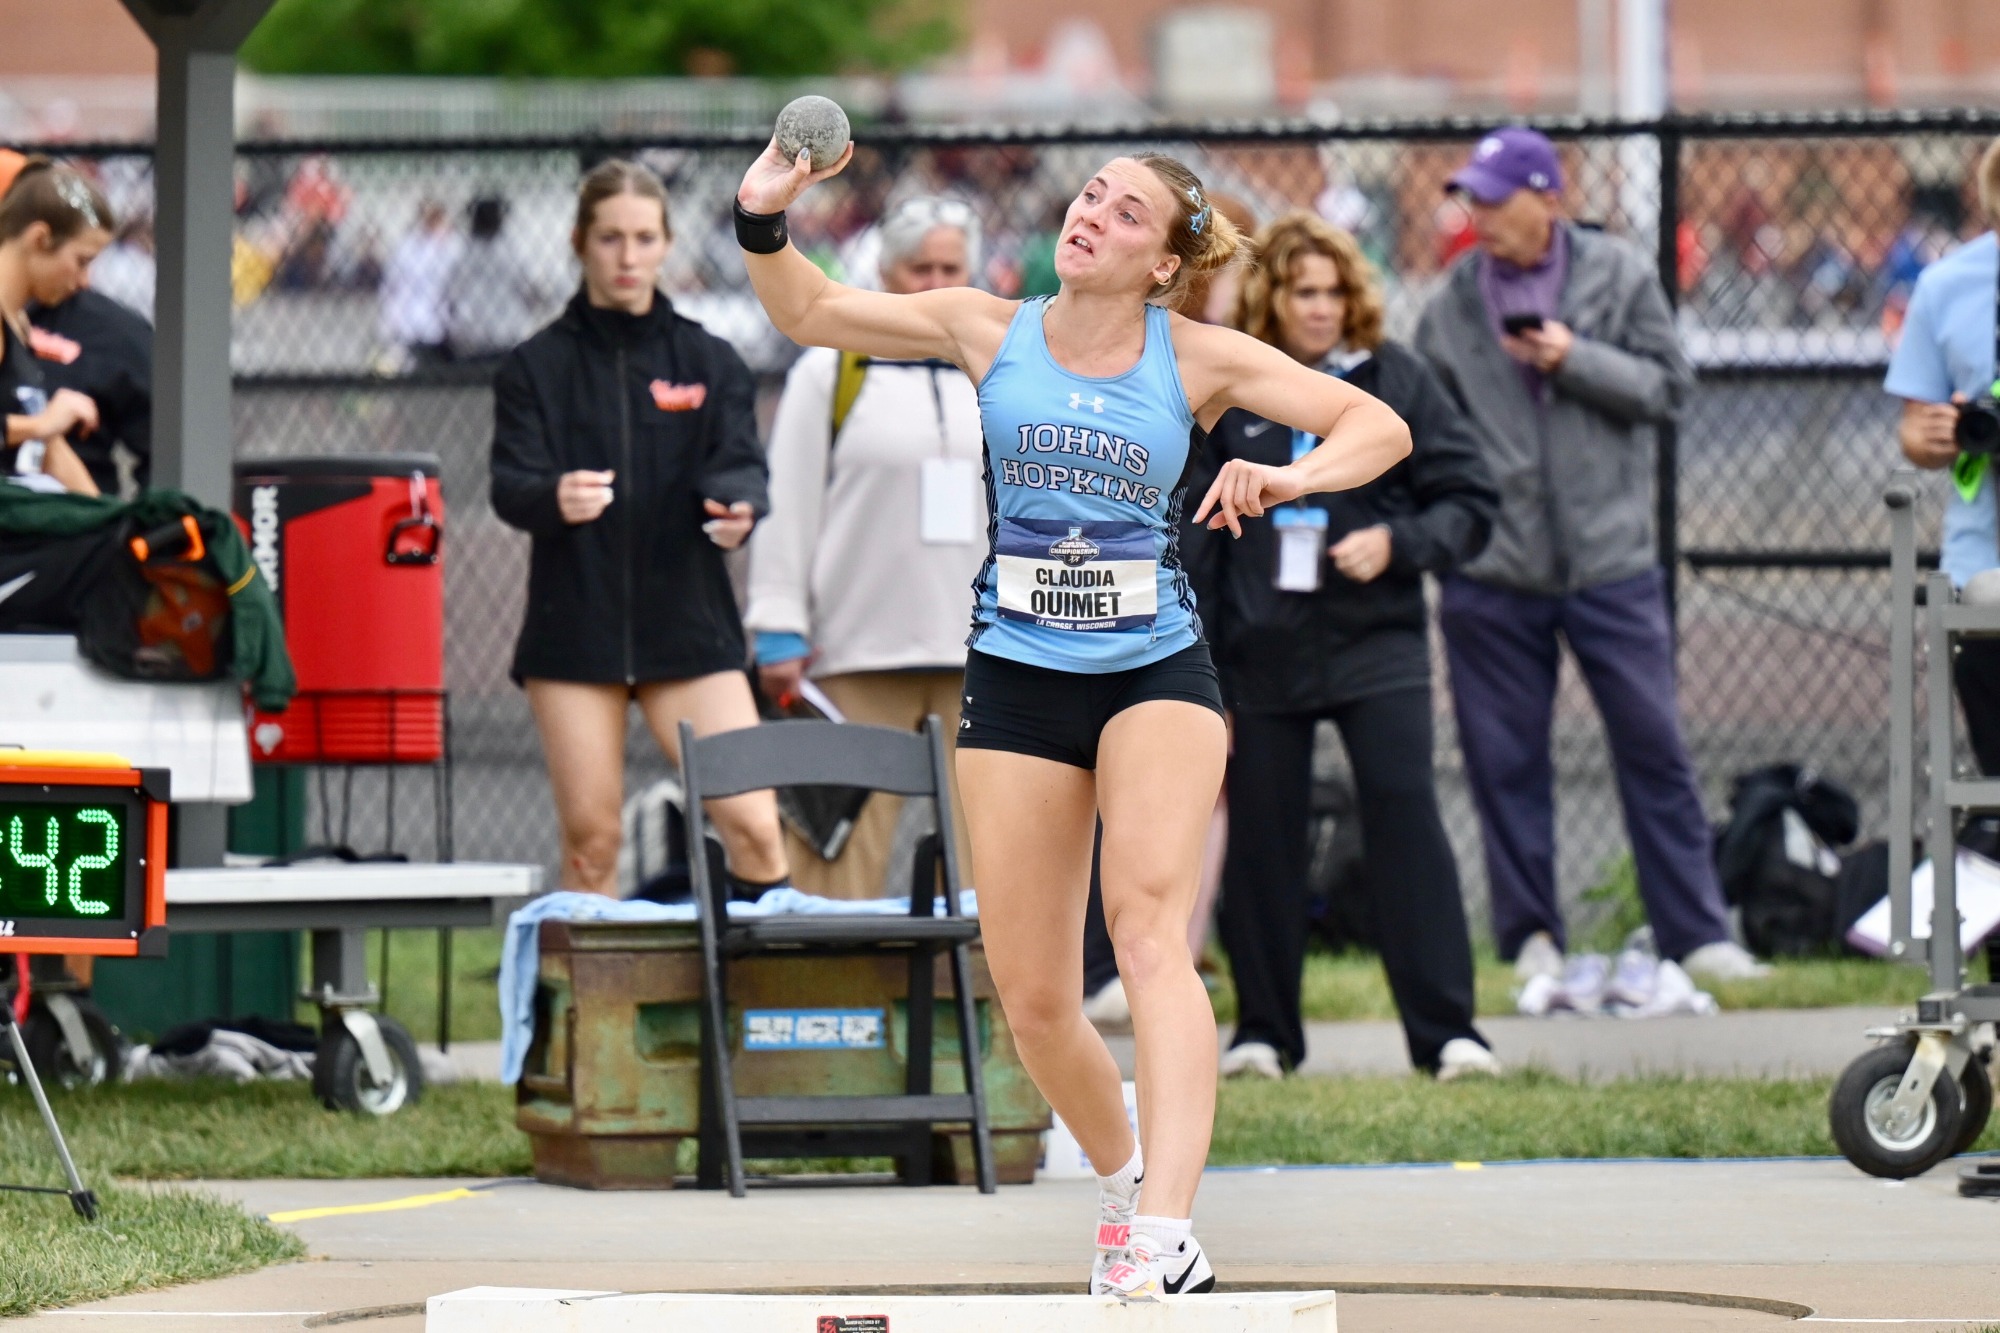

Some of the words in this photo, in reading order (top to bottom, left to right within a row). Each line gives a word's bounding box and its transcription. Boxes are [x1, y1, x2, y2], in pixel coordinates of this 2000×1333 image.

[1017, 423, 1149, 477] JOHNS
[1000, 458, 1161, 510] HOPKINS
[1050, 547, 1098, 555] CHAMPIONSHIPS
[1035, 567, 1115, 588] CLAUDIA
[1030, 589, 1122, 618] OUIMET
[1036, 618, 1045, 626] LA
[1076, 620, 1117, 630] WISCONSIN
[1097, 1223, 1131, 1246] NIKE
